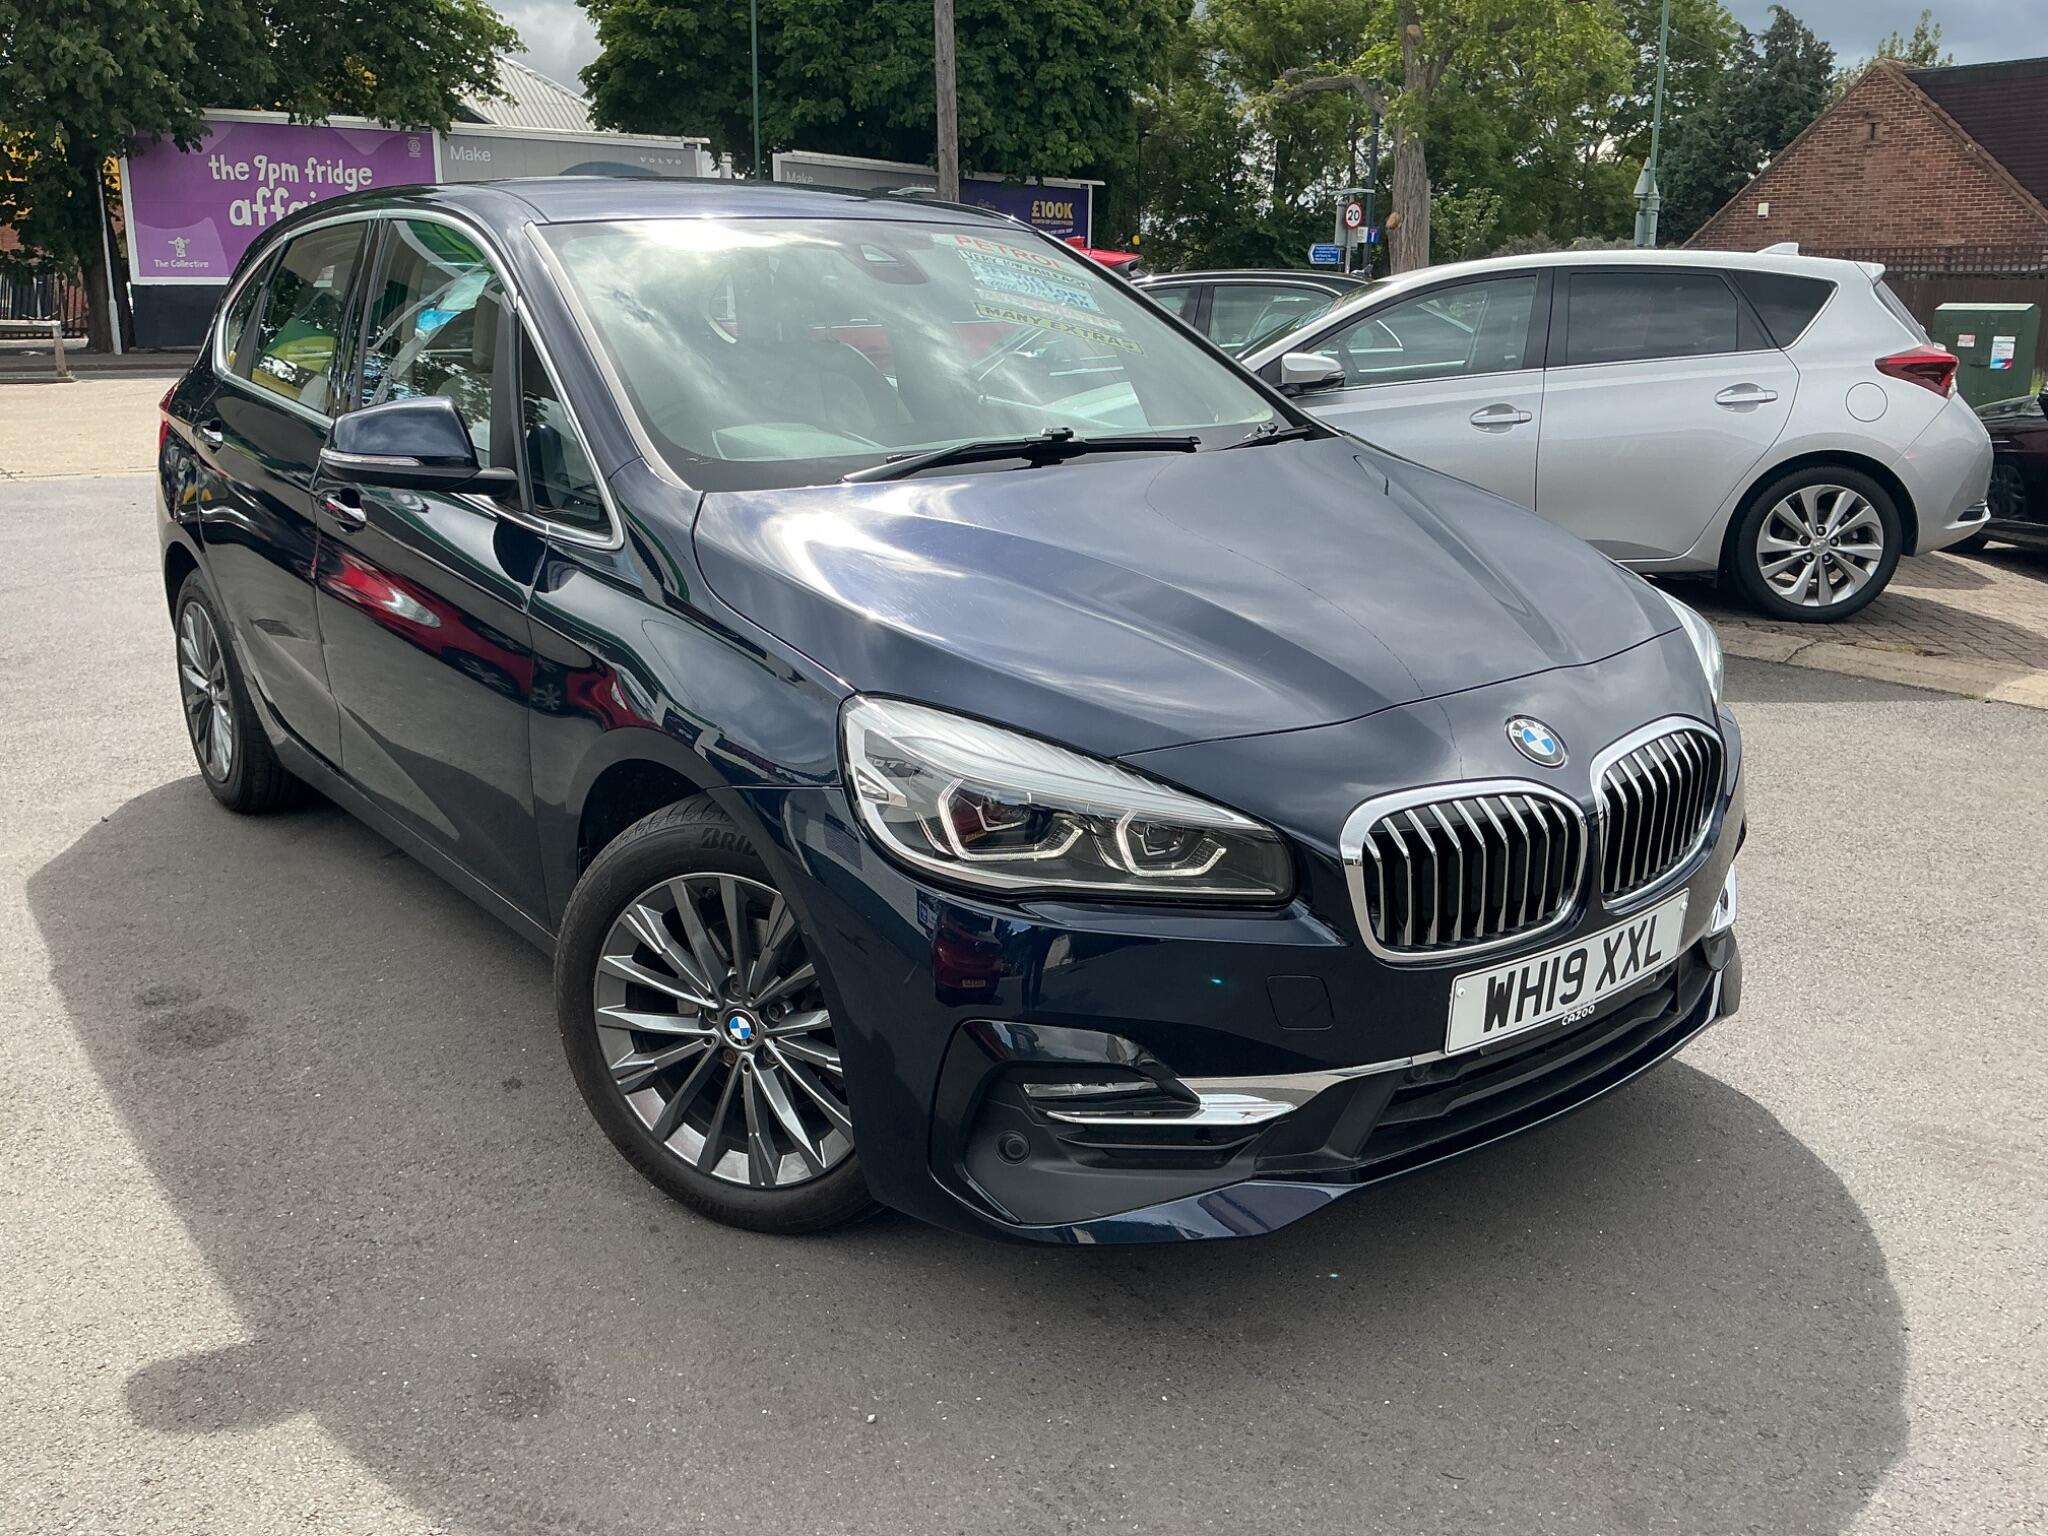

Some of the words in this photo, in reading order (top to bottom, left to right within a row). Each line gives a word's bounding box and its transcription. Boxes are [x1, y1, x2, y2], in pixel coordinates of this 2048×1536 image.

[450, 145, 491, 162] Make
[640, 156, 682, 165] VOLVO
[208, 154, 249, 181] the
[254, 155, 299, 189] 9pm
[305, 157, 373, 191] fridge
[786, 170, 814, 185] Make
[229, 186, 317, 226] aff
[1031, 200, 1073, 219] £100K
[1347, 209, 1360, 221] 20
[154, 259, 169, 268] The
[170, 259, 209, 268] Collective
[984, 306, 1041, 326] MANY
[1049, 320, 1135, 350] EXTRAS
[1482, 947, 1589, 1034] WH19
[1594, 914, 1662, 992] XXL
[1561, 1004, 1596, 1026] CAZOO
